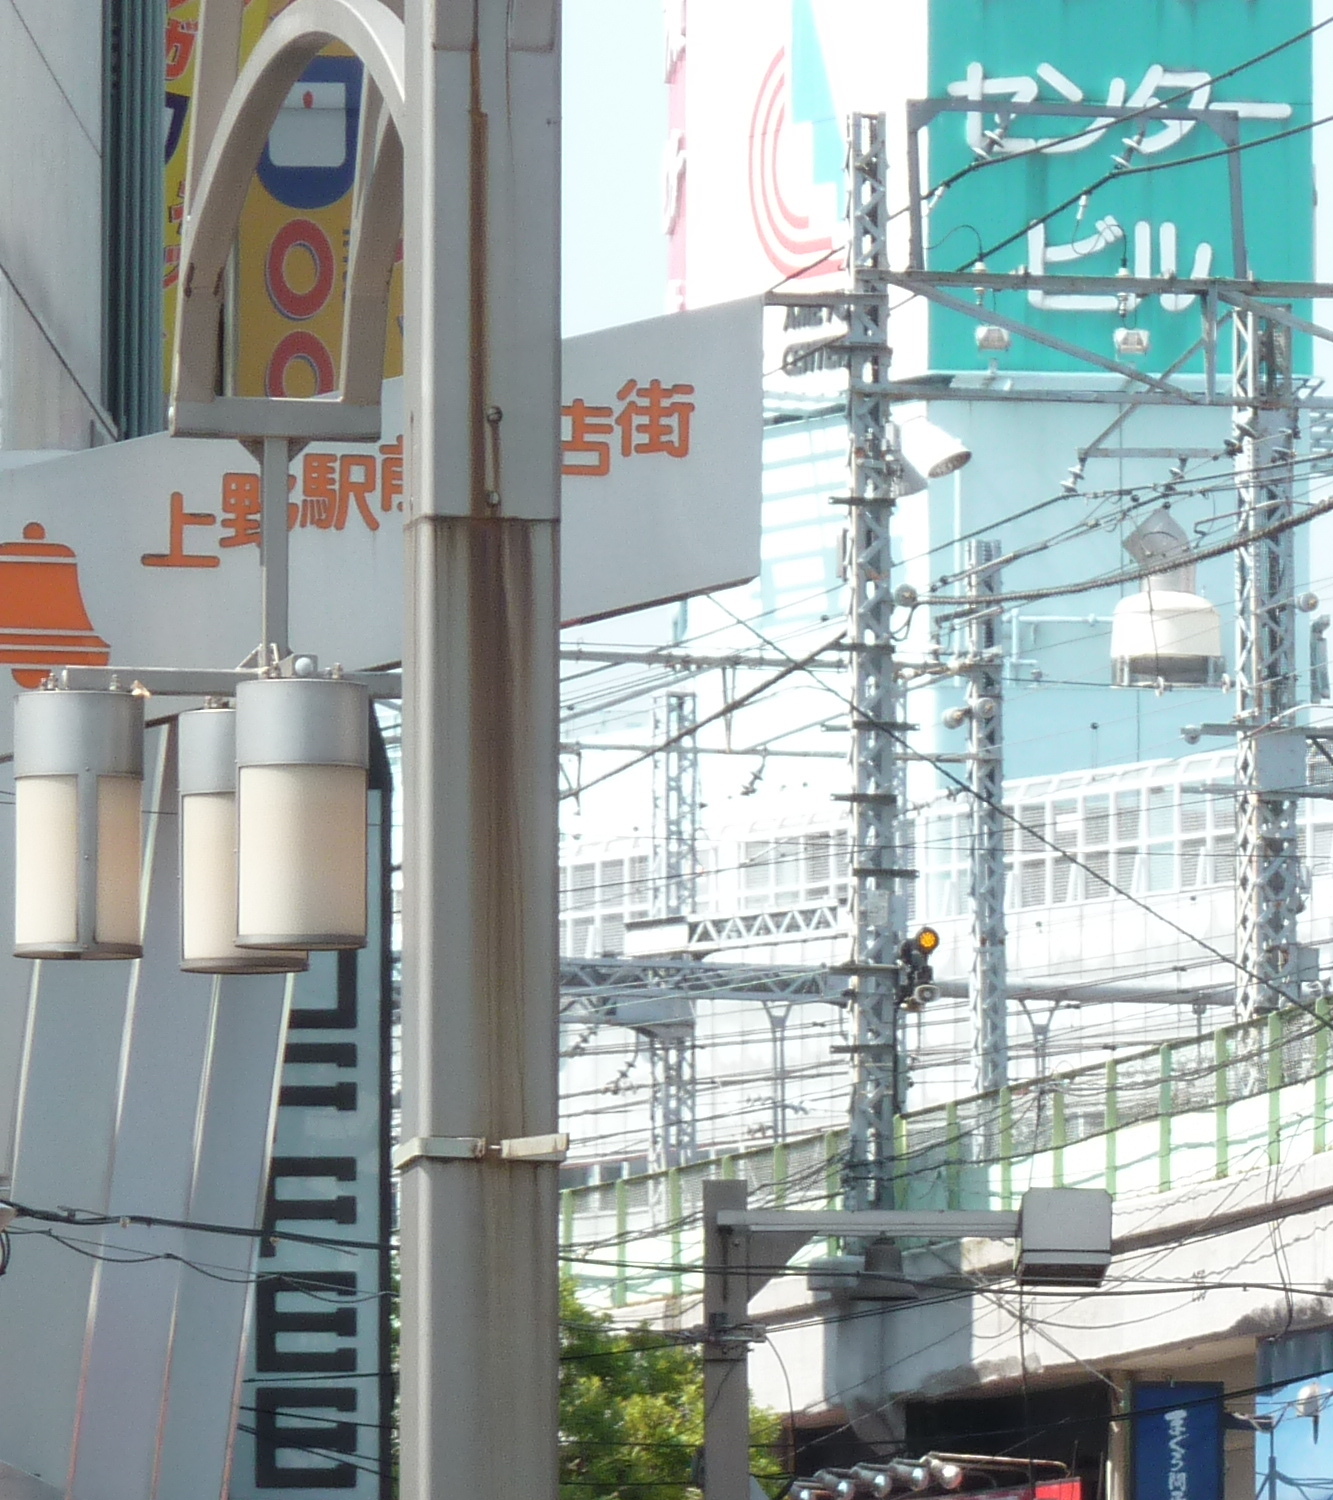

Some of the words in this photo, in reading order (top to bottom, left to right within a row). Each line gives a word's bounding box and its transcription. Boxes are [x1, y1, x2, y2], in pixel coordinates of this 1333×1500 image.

[948, 62, 1292, 154] センター
[1027, 216, 1212, 312] ビル
